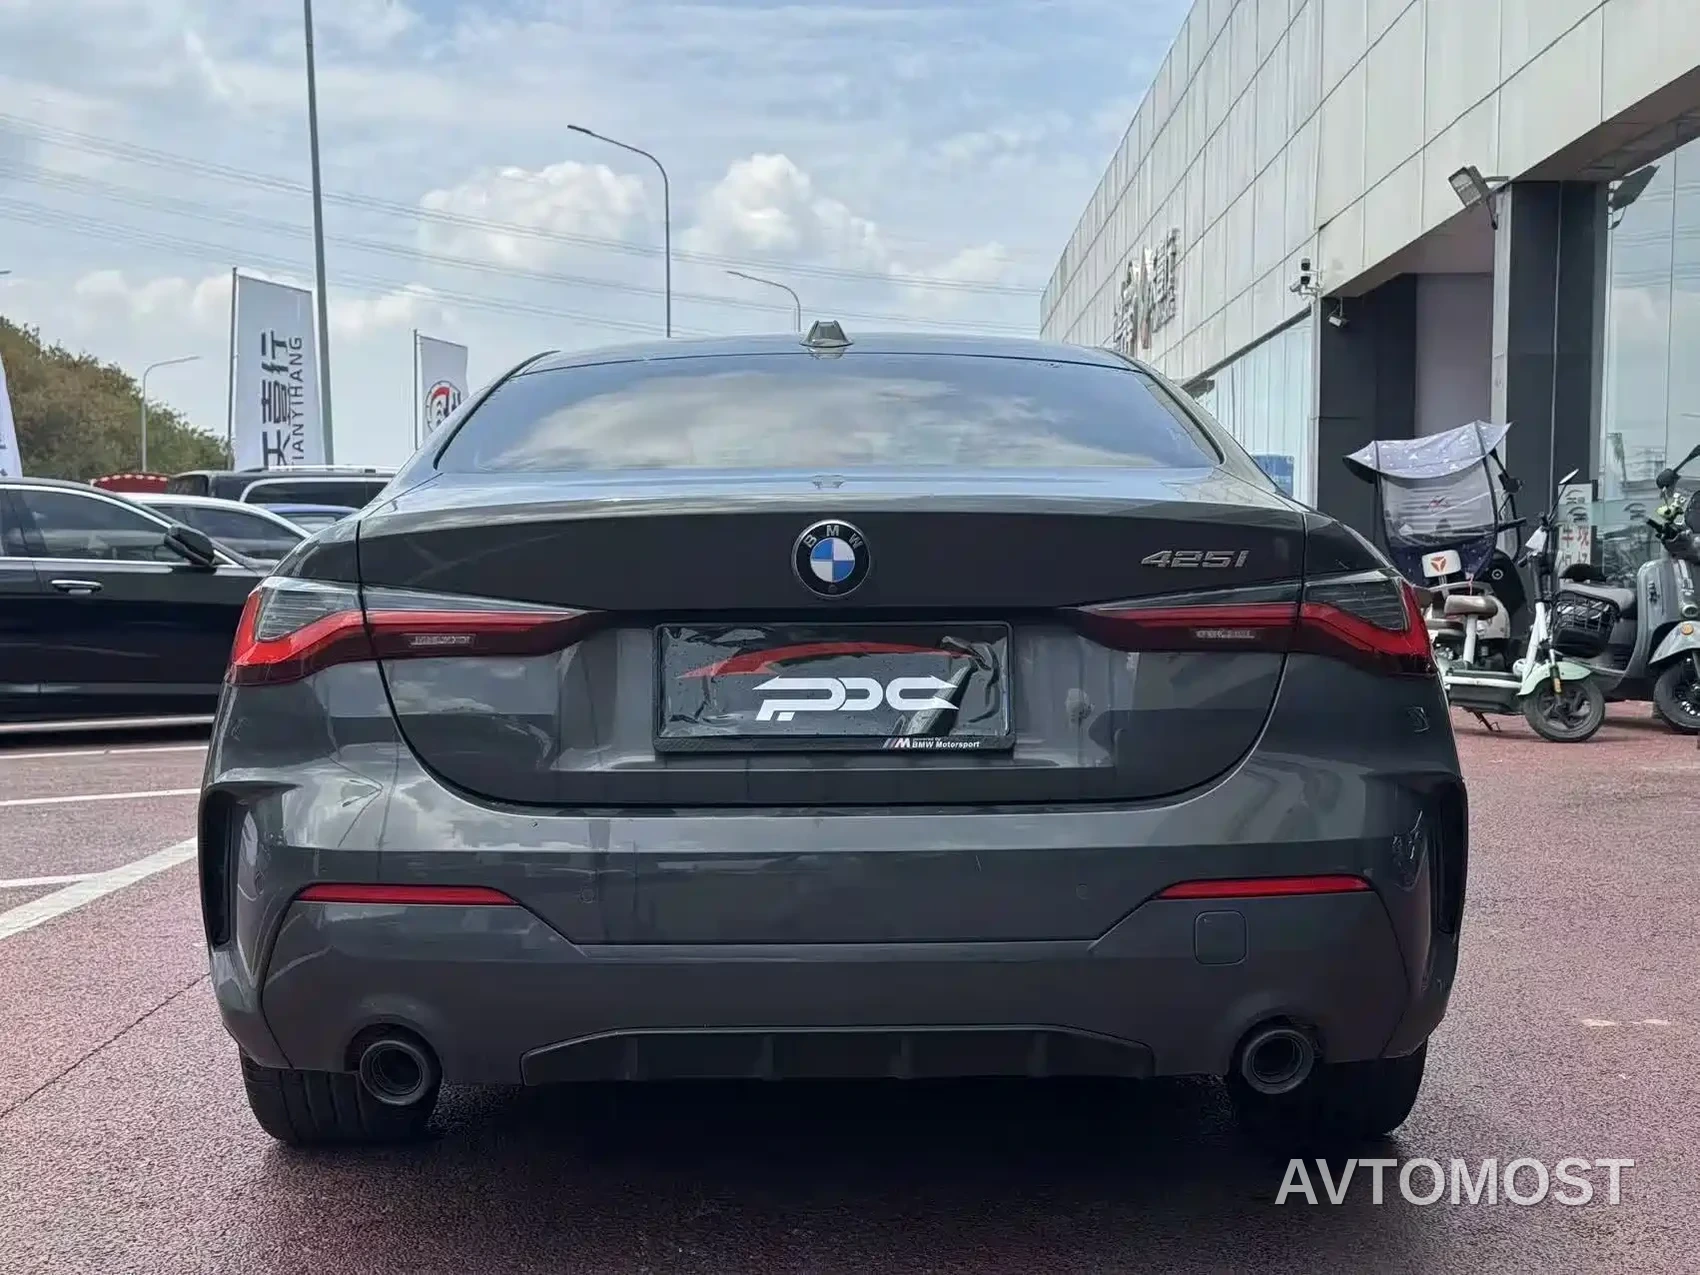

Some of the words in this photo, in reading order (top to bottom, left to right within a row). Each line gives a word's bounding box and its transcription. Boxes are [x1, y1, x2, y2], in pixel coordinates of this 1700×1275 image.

[288, 336, 304, 466] IANYIHANG
[803, 525, 863, 549] BMW
[911, 741, 933, 749] BMW
[935, 740, 980, 750] Motorsport
